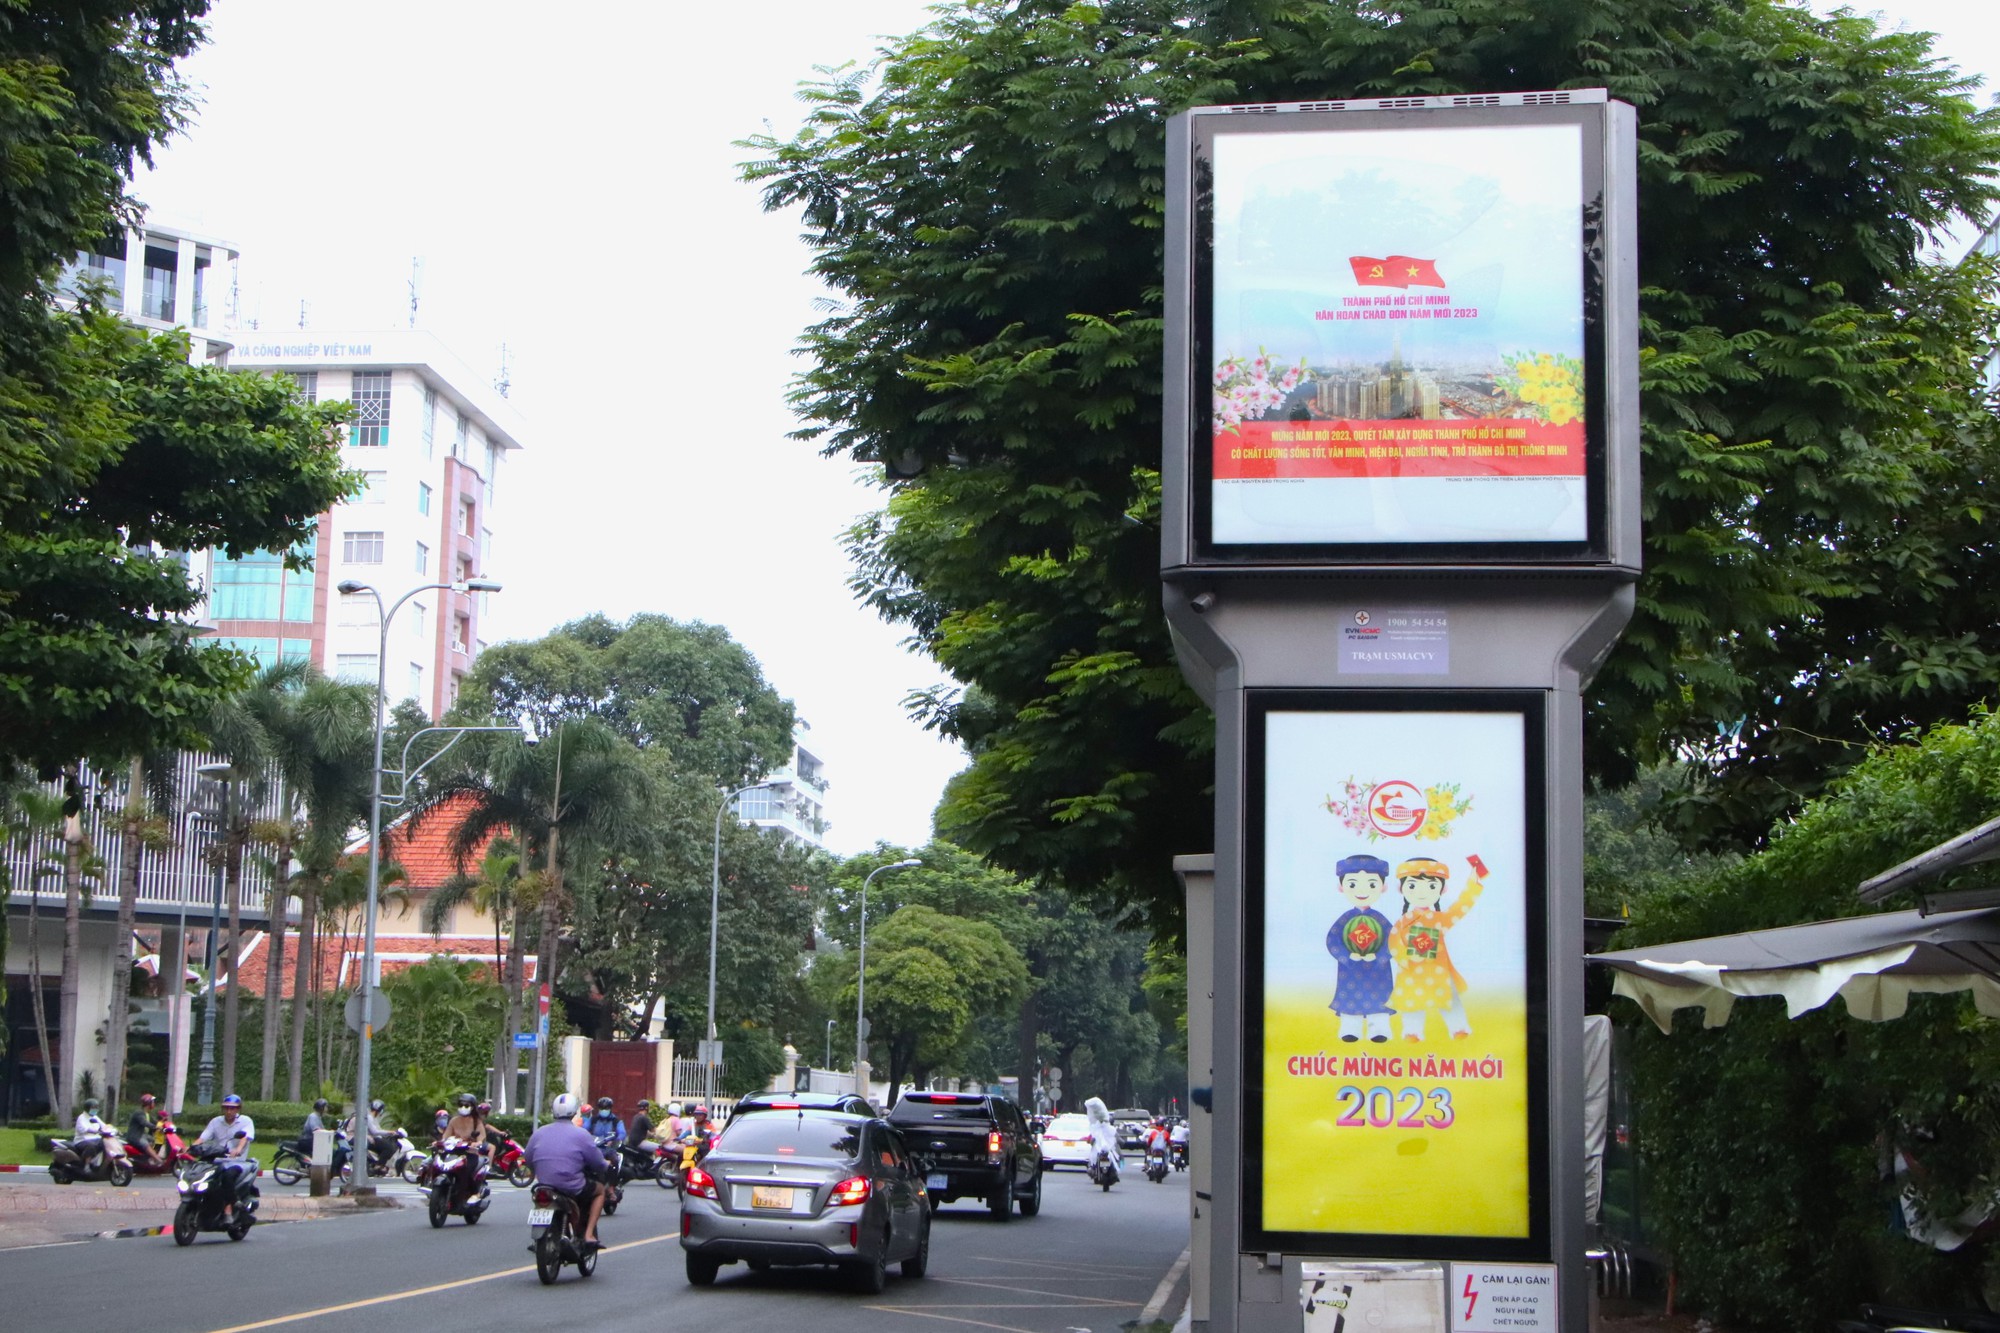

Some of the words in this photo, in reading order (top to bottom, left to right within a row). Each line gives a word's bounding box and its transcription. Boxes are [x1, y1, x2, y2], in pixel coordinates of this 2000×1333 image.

[1343, 296, 1371, 306] THÀNH
[1374, 294, 1392, 306] PHỐ
[1408, 295, 1423, 305] CHÍ
[1425, 295, 1450, 305] MINH
[1336, 310, 1360, 320] HOAN
[1363, 309, 1386, 319] CHÀO
[1410, 308, 1431, 319] NĂM
[1434, 308, 1452, 318] MỚI
[1454, 308, 1478, 318] 2023
[239, 343, 249, 357] VÀ
[253, 344, 281, 357] CÔNG
[283, 343, 320, 359] NGHIỆP
[324, 343, 346, 359] VIỆT
[349, 344, 372, 356] NAM
[1315, 429, 1330, 440] MỚI
[1331, 430, 1352, 441] 2023,
[1353, 427, 1376, 440] QUYẾT
[1396, 428, 1411, 440] XÂY
[1435, 427, 1460, 439] THÀNH
[1461, 426, 1477, 439] PHỐ
[1491, 426, 1504, 438] CHÍ
[1506, 428, 1526, 438] MINH
[1290, 445, 1310, 458] SỐNG
[1369, 445, 1387, 460] HIỆN
[1452, 443, 1466, 456] TRỞ
[1468, 444, 1493, 456] THÀNH
[1506, 445, 1519, 458] THỊ
[1547, 445, 1568, 456] MINH
[1388, 618, 1407, 627] 1900
[1412, 618, 1422, 627] 54
[1424, 618, 1434, 627] 54
[1437, 618, 1447, 627] 54
[1352, 651, 1381, 662] TRẠM
[1287, 1051, 1338, 1076] CHÚC
[1343, 1052, 1402, 1077] MỪNG
[1408, 1054, 1457, 1079] NĂM
[1461, 1054, 1503, 1079] MỚI
[1336, 1085, 1455, 1129] 2023
[1507, 1275, 1522, 1286] LẠI
[1492, 1295, 1509, 1303] ĐIỆN
[1493, 1317, 1512, 1325] CHẾT
[1514, 1318, 1538, 1327] NGƯỜI
